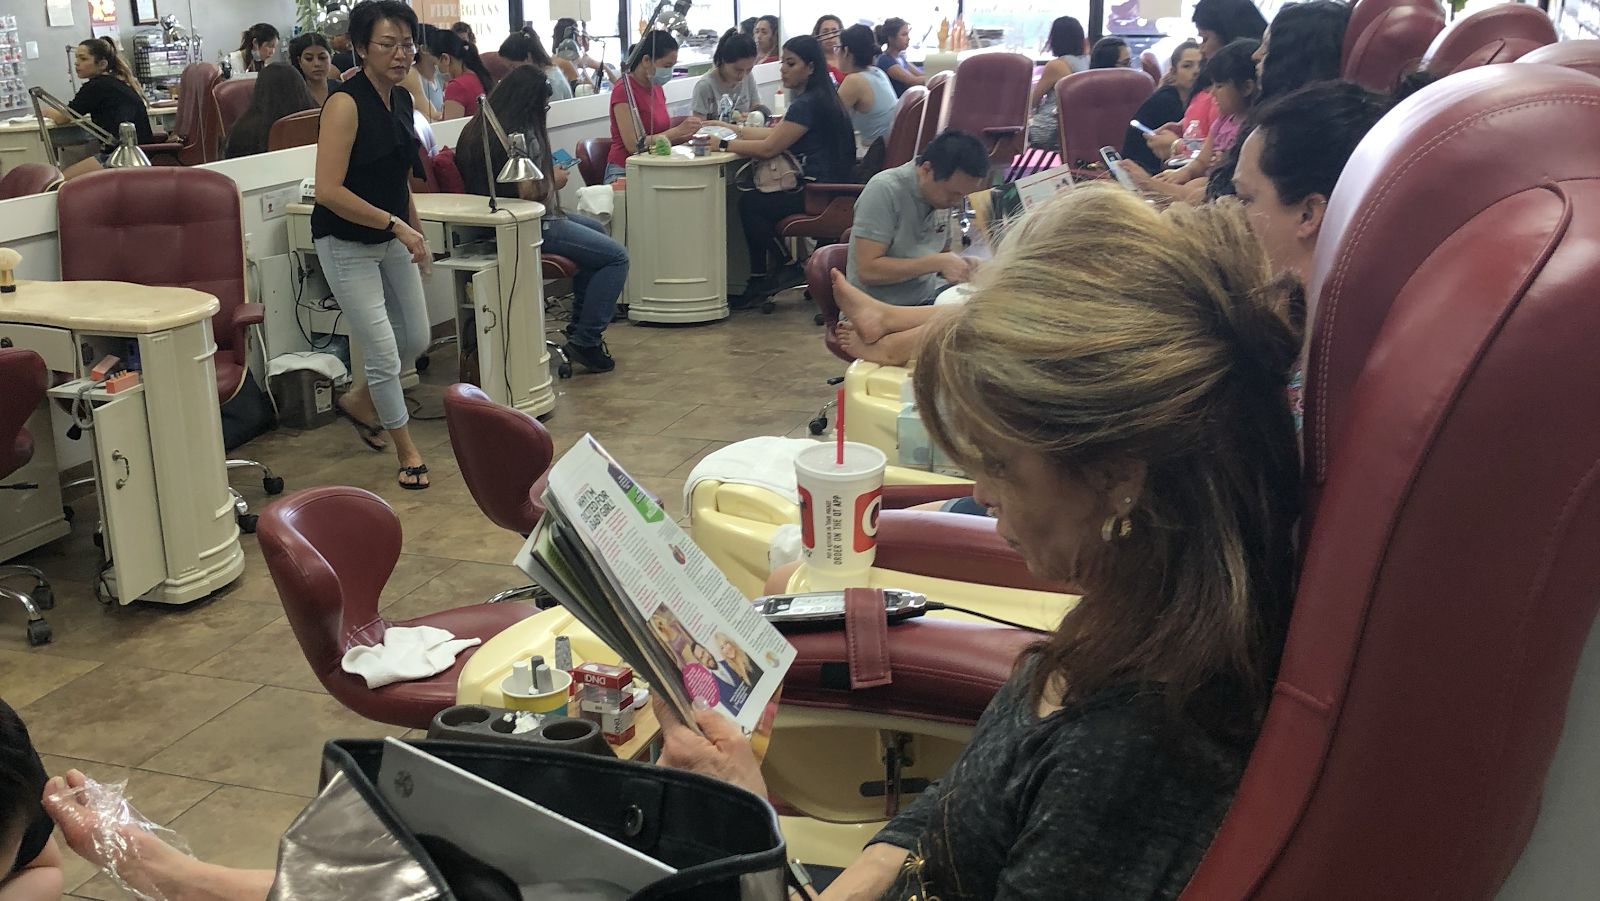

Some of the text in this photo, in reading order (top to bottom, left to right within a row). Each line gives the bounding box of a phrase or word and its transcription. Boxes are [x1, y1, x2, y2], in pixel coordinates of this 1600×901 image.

[595, 489, 610, 507] FOR
[833, 495, 842, 565] ORDER ON THE QT APP
